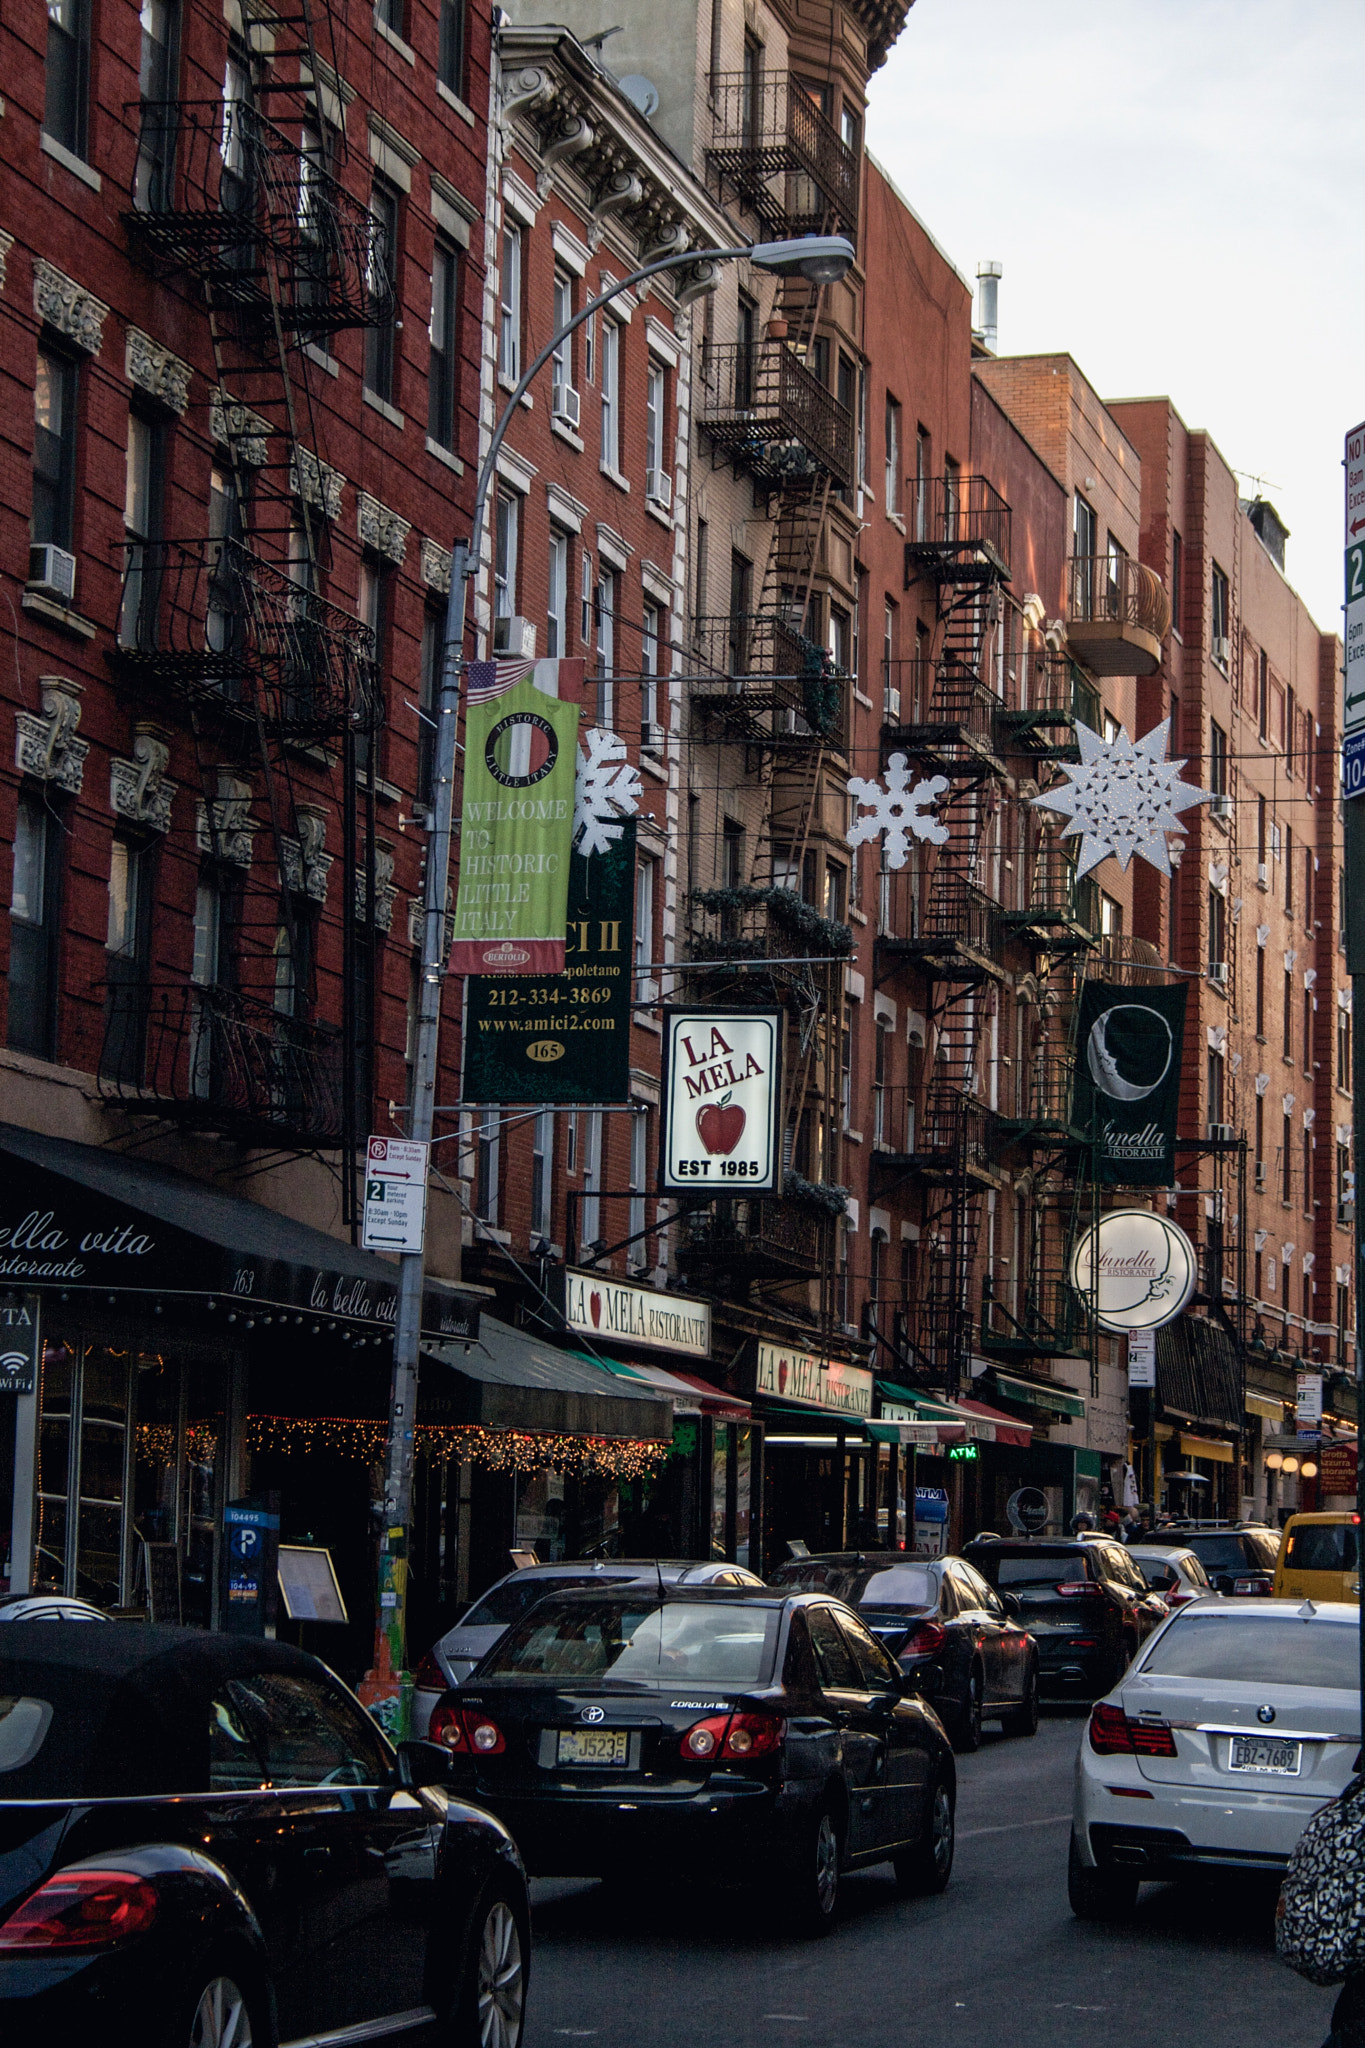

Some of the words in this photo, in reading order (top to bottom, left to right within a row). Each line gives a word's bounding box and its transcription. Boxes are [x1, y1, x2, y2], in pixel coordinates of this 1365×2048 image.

[1348, 439, 1361, 463] NO
[1349, 469, 1364, 488] 8am
[1351, 548, 1364, 597] 2
[1348, 622, 1364, 642] 6pm
[496, 714, 551, 733] HISTORIC
[486, 754, 520, 787] LITTLE
[526, 750, 556, 785] ITALY
[466, 799, 568, 822] WELCOME
[466, 830, 490, 849] TO
[465, 853, 559, 876] HISTORIC
[463, 883, 530, 904] LITTLE
[460, 910, 518, 931] ITALY
[598, 920, 623, 952] II
[488, 953, 526, 962] BERTOLLI
[488, 987, 612, 1006] 212-334-3869
[478, 1014, 615, 1032] www.amici2.com
[533, 1043, 559, 1059] 165
[680, 1026, 734, 1067] LA
[682, 1052, 765, 1099] MELA
[389, 1152, 404, 1161] Except
[405, 1154, 422, 1163] Sunday
[1107, 1147, 1165, 1158] RISTORANTE
[678, 1160, 712, 1176] EST
[719, 1160, 759, 1176] 1985
[371, 1181, 381, 1200] 2
[386, 1190, 407, 1199] metered
[386, 1197, 405, 1206] parking
[367, 1215, 386, 1225] Except
[387, 1217, 408, 1228] Sunday
[368, 1207, 389, 1217] 8:30am
[393, 1209, 408, 1219] 10pm
[79, 1223, 156, 1255] vita
[1081, 1247, 1157, 1271] Lunella
[1107, 1268, 1157, 1277] RISTORANTE
[232, 1268, 255, 1295] 163
[310, 1271, 329, 1309] la
[333, 1275, 372, 1318] bella
[567, 1277, 588, 1325] LA
[605, 1286, 648, 1337] MELA
[649, 1308, 706, 1347] RISTORANTE
[1130, 1352, 1137, 1362] 2
[758, 1346, 775, 1391] LA
[789, 1355, 822, 1403] MELA
[825, 1379, 869, 1414] RISTORANTE
[950, 1446, 977, 1459] ATM
[231, 1512, 260, 1522] 104495
[670, 1700, 715, 1709] COROLLA
[1236, 1746, 1258, 1765] EBZ
[1266, 1748, 1295, 1768] 7689
